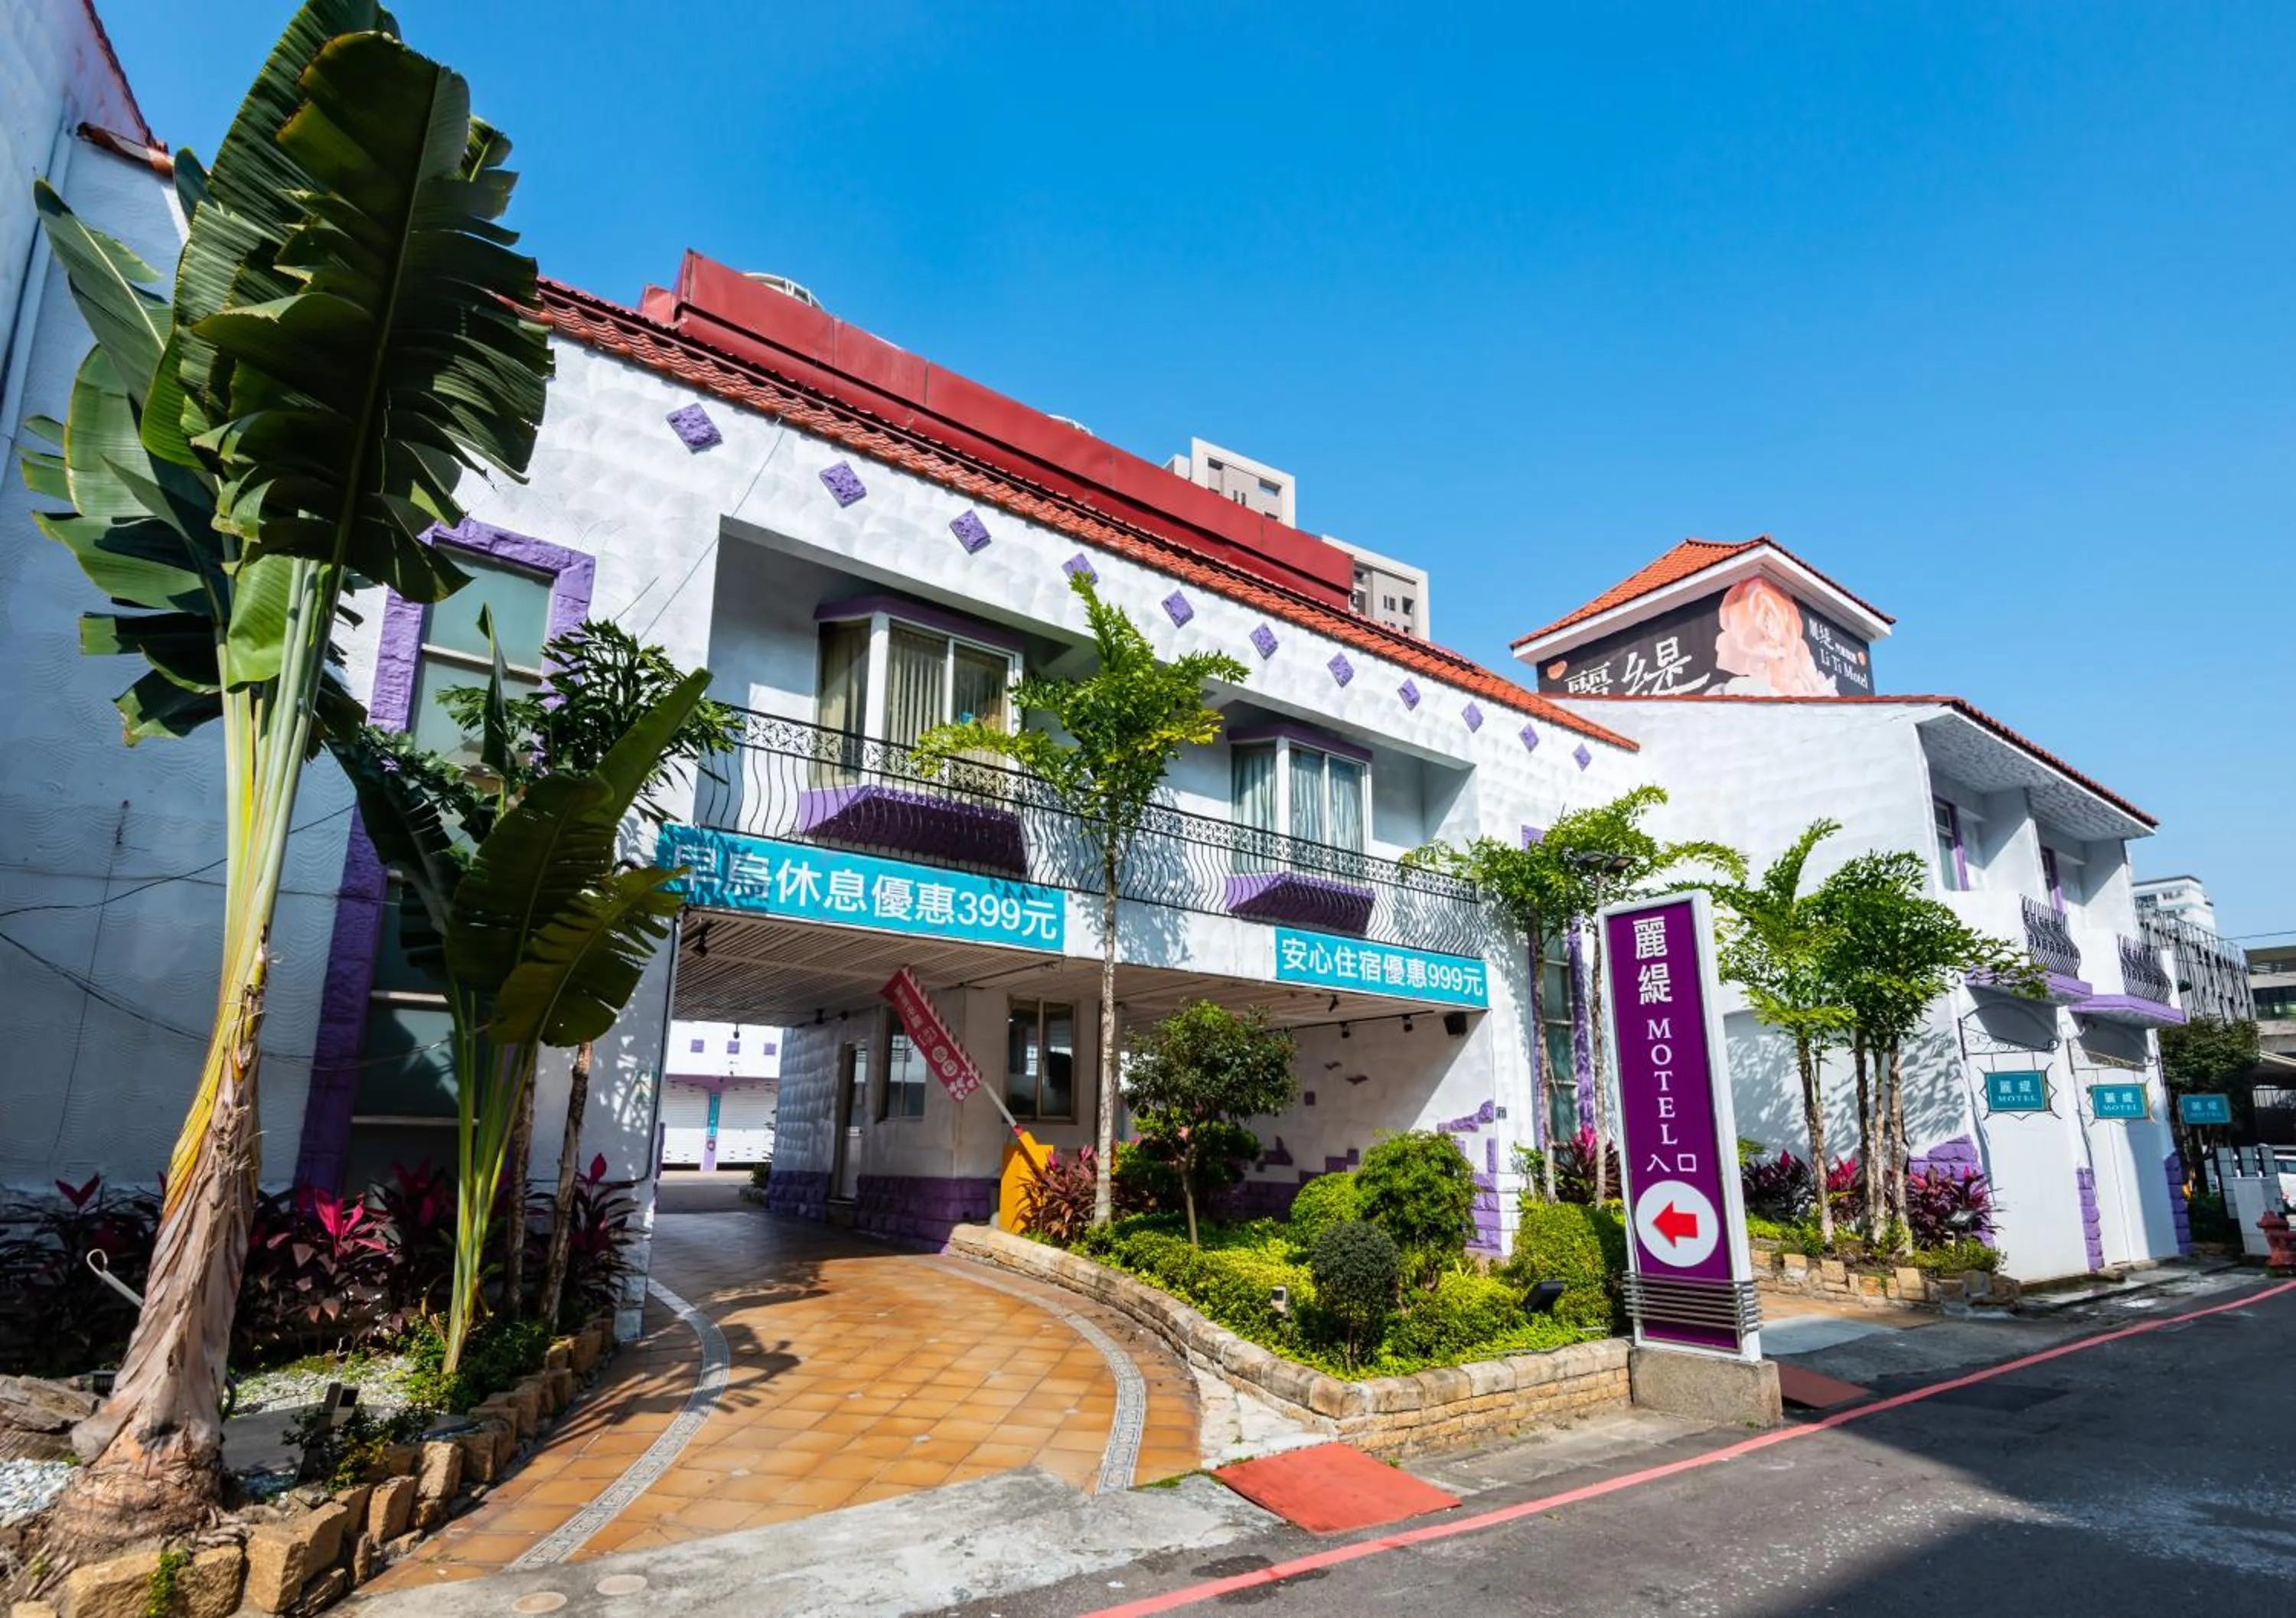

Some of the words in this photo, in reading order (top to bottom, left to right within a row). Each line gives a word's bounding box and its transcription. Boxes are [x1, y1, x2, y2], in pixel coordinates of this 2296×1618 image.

[1281, 938, 1484, 997] 安心住宿優惠999元
[1632, 916, 1673, 1005] 麗緹
[1646, 1017, 1678, 1145] MOTEL
[1646, 1153, 1697, 1173] 入口
